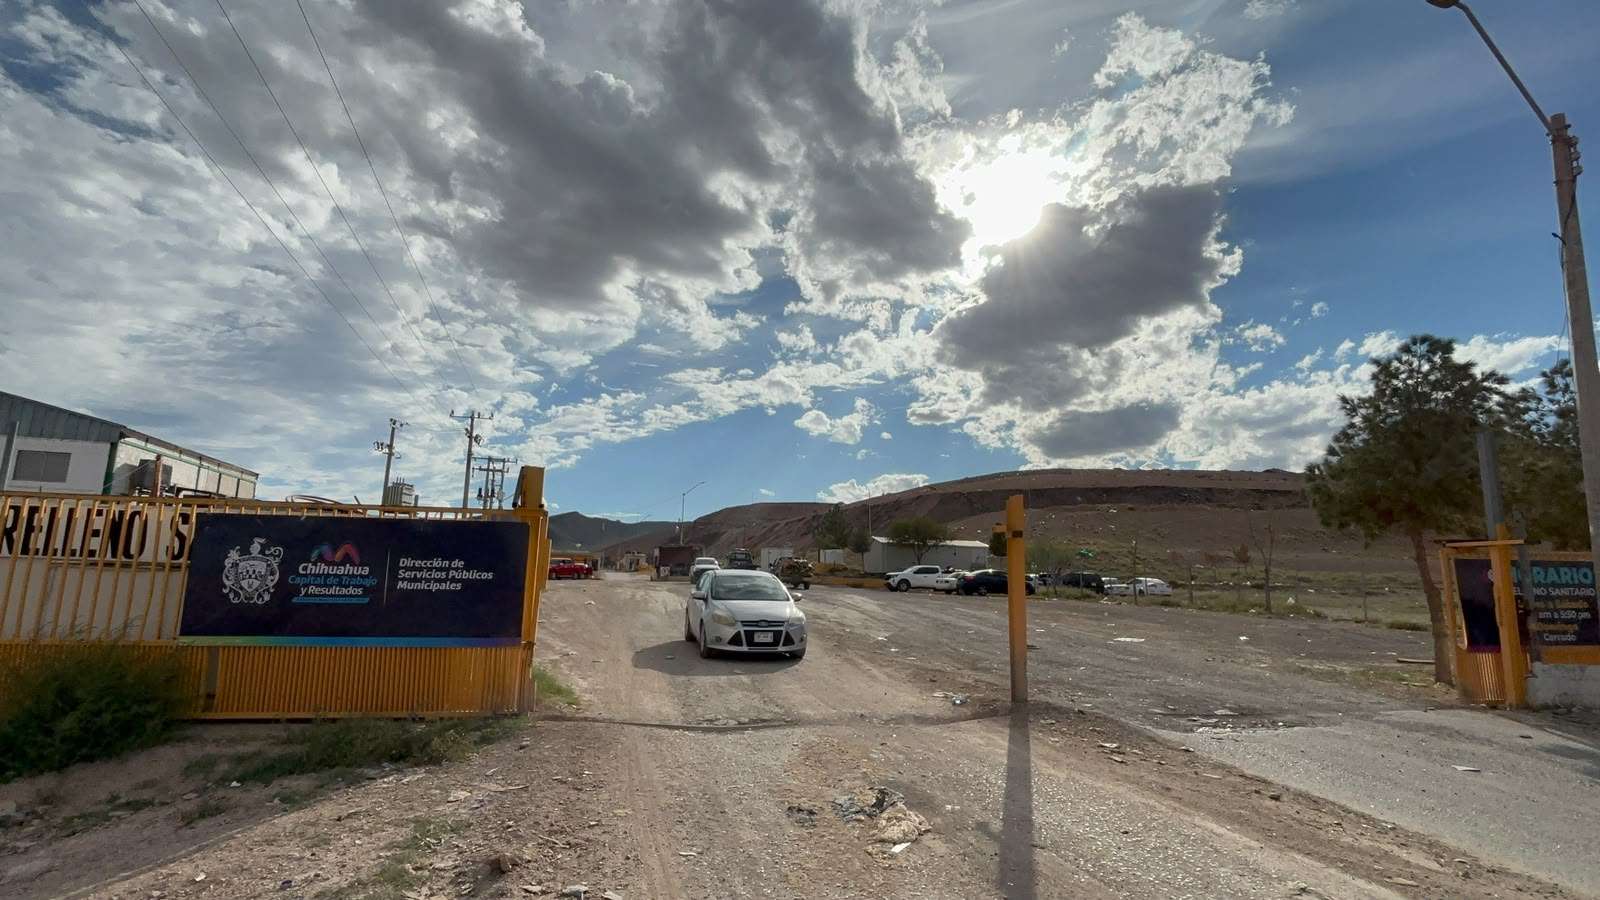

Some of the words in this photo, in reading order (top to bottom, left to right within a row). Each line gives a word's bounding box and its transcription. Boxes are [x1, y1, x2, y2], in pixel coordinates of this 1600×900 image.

[399, 558, 449, 568] Dirección
[451, 559, 465, 568] de
[298, 563, 370, 575] Chihuahua
[398, 569, 447, 579] Servicios
[448, 570, 493, 579] Públicos
[288, 575, 324, 587] Capital
[326, 576, 339, 585] de
[342, 577, 378, 588] Trabajo
[397, 581, 462, 592] Municipales
[300, 587, 307, 597] y
[308, 585, 364, 595] Resultados
[1548, 587, 1596, 597] SANITARIO
